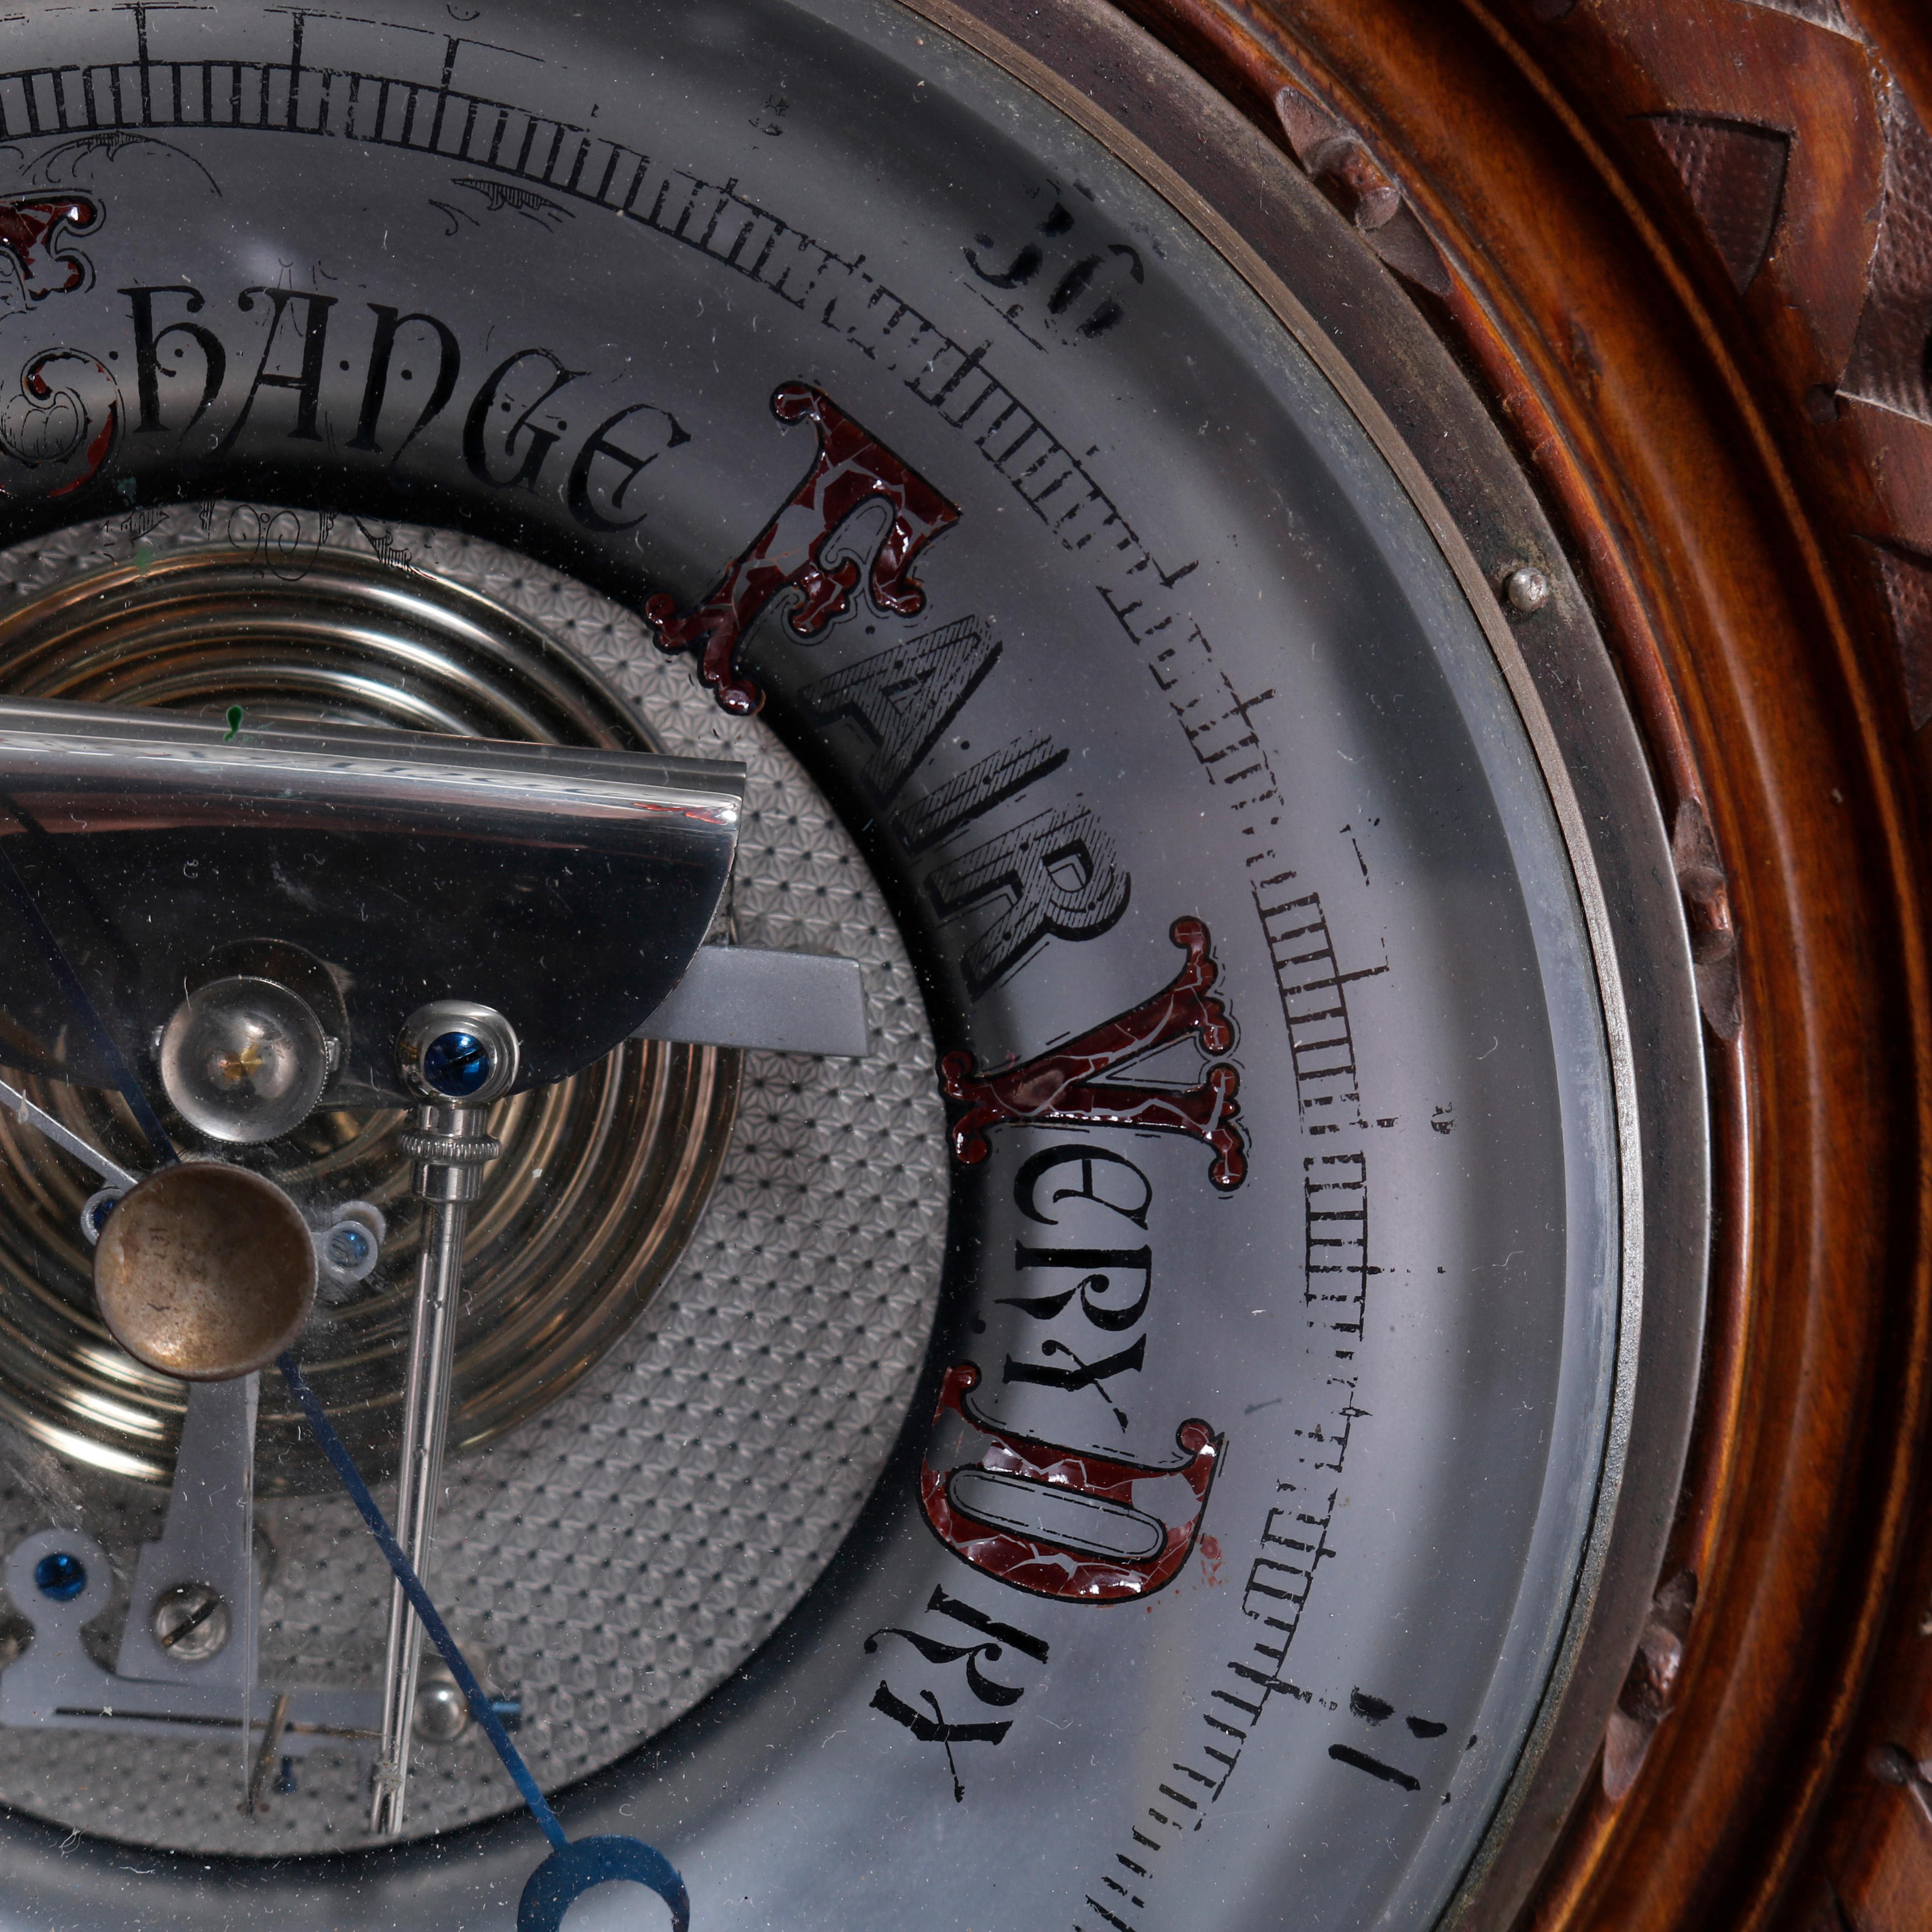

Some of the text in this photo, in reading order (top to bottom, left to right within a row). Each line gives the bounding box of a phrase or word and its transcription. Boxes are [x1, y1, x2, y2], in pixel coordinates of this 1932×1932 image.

[643, 380, 1131, 1000] FAIR
[864, 915, 1250, 1803] VERY DRY
